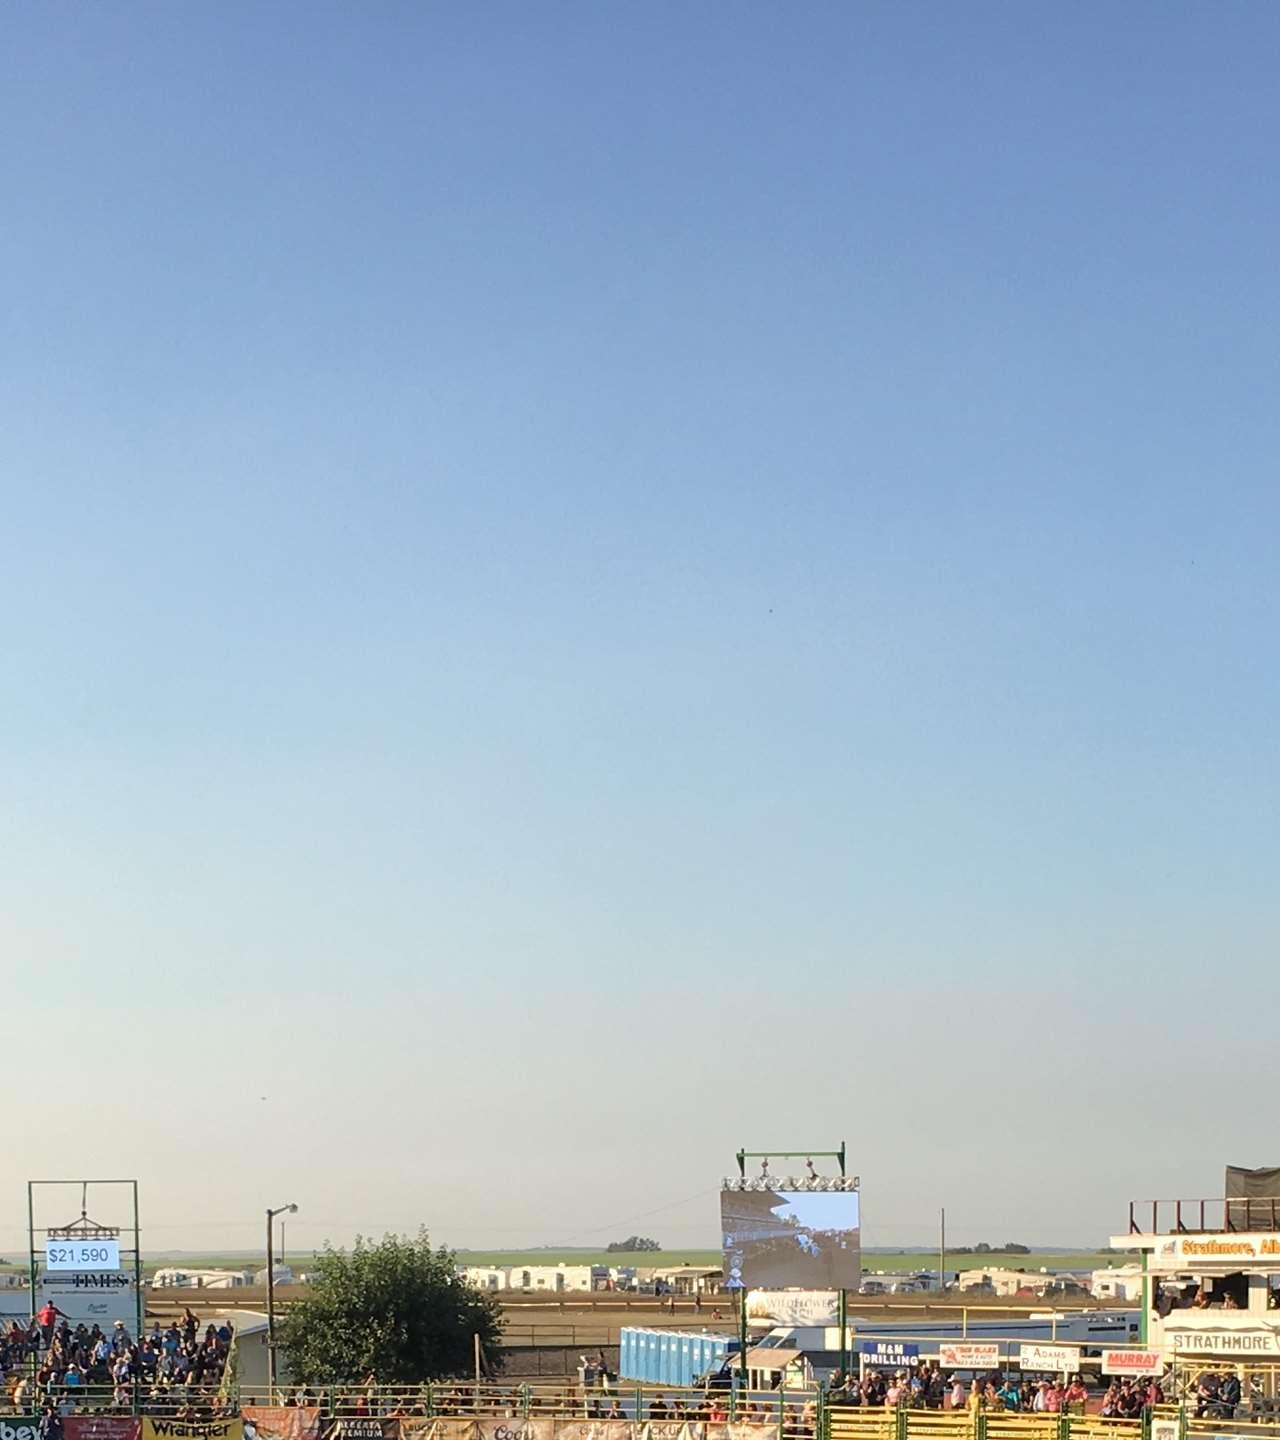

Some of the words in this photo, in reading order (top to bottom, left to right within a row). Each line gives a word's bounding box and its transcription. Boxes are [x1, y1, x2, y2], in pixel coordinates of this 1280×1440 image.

[1182, 1240, 1256, 1256] Strathmore,
[49, 1248, 109, 1264] $21,590
[73, 1274, 126, 1288] TIMES
[877, 1343, 904, 1355] M&M
[1174, 1335, 1272, 1350] STRATHMORE
[863, 1354, 919, 1366] DRILLING
[1107, 1352, 1160, 1366] MURRAY
